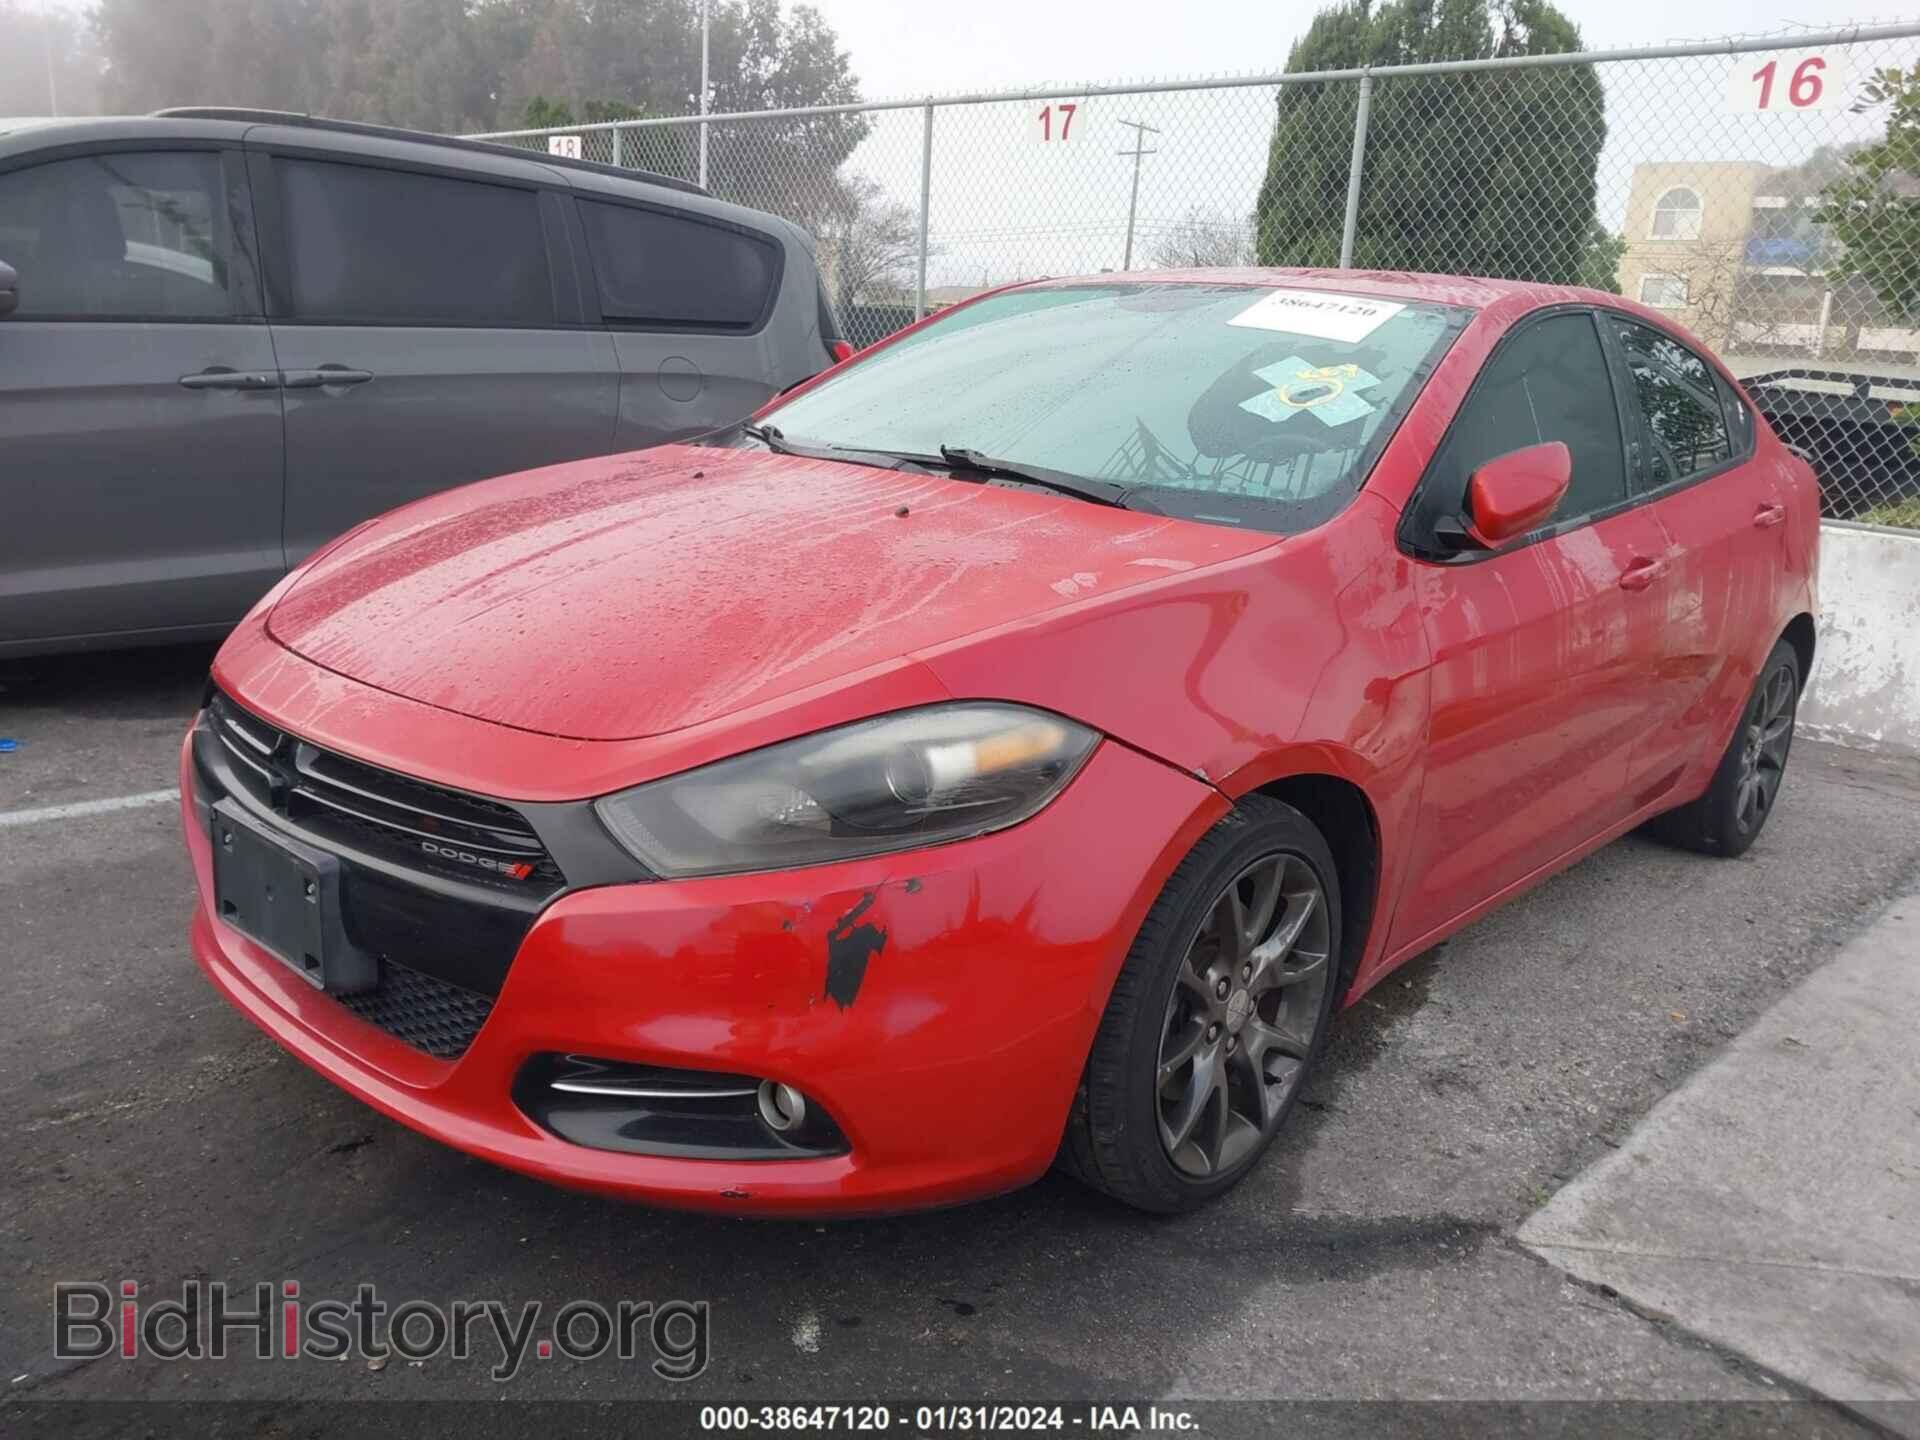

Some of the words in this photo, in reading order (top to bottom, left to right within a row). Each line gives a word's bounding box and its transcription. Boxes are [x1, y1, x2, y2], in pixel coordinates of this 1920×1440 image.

[1752, 57, 1826, 109] 16
[1039, 104, 1076, 140] 17
[555, 138, 575, 158] 18
[421, 841, 516, 875] DODGE
